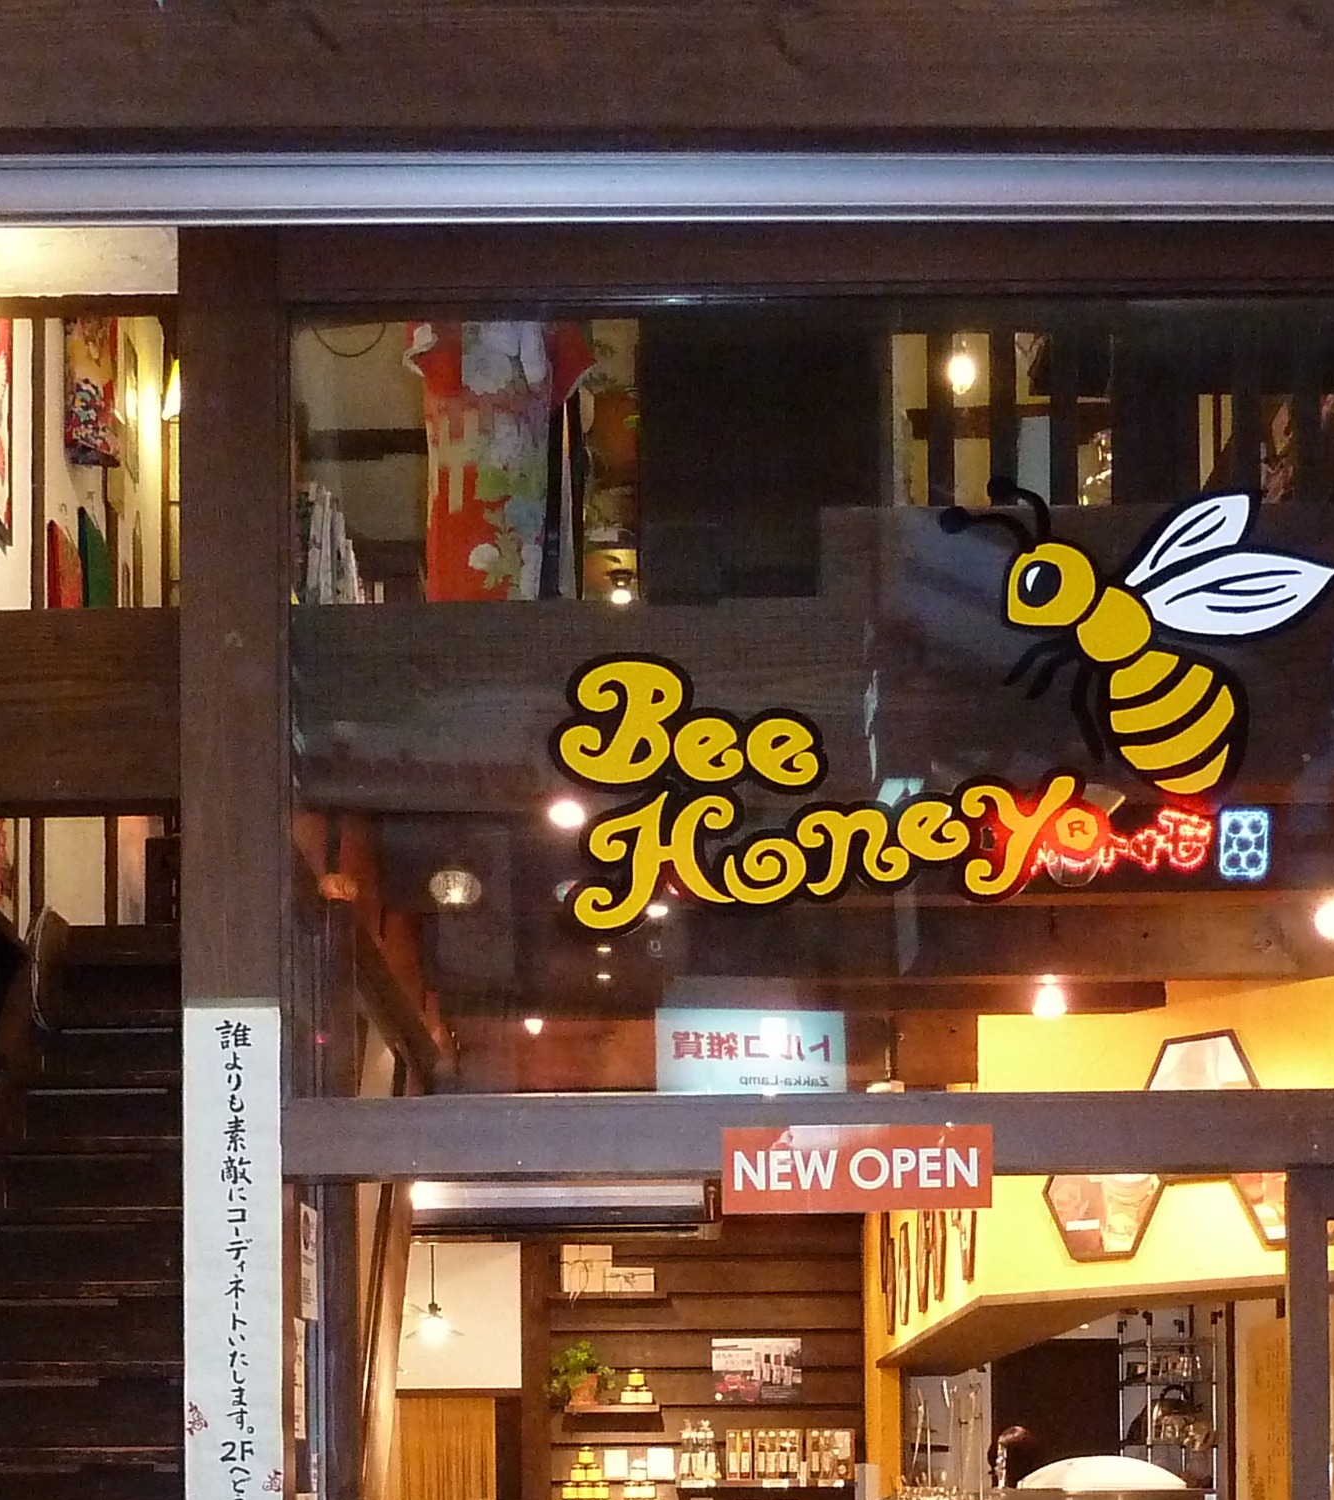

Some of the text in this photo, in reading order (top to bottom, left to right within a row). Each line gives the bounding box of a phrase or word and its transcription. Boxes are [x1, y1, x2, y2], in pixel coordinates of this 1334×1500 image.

[551, 655, 826, 790] Bee
[571, 775, 1083, 934] Honey
[734, 1147, 980, 1192] NEW OPEN
